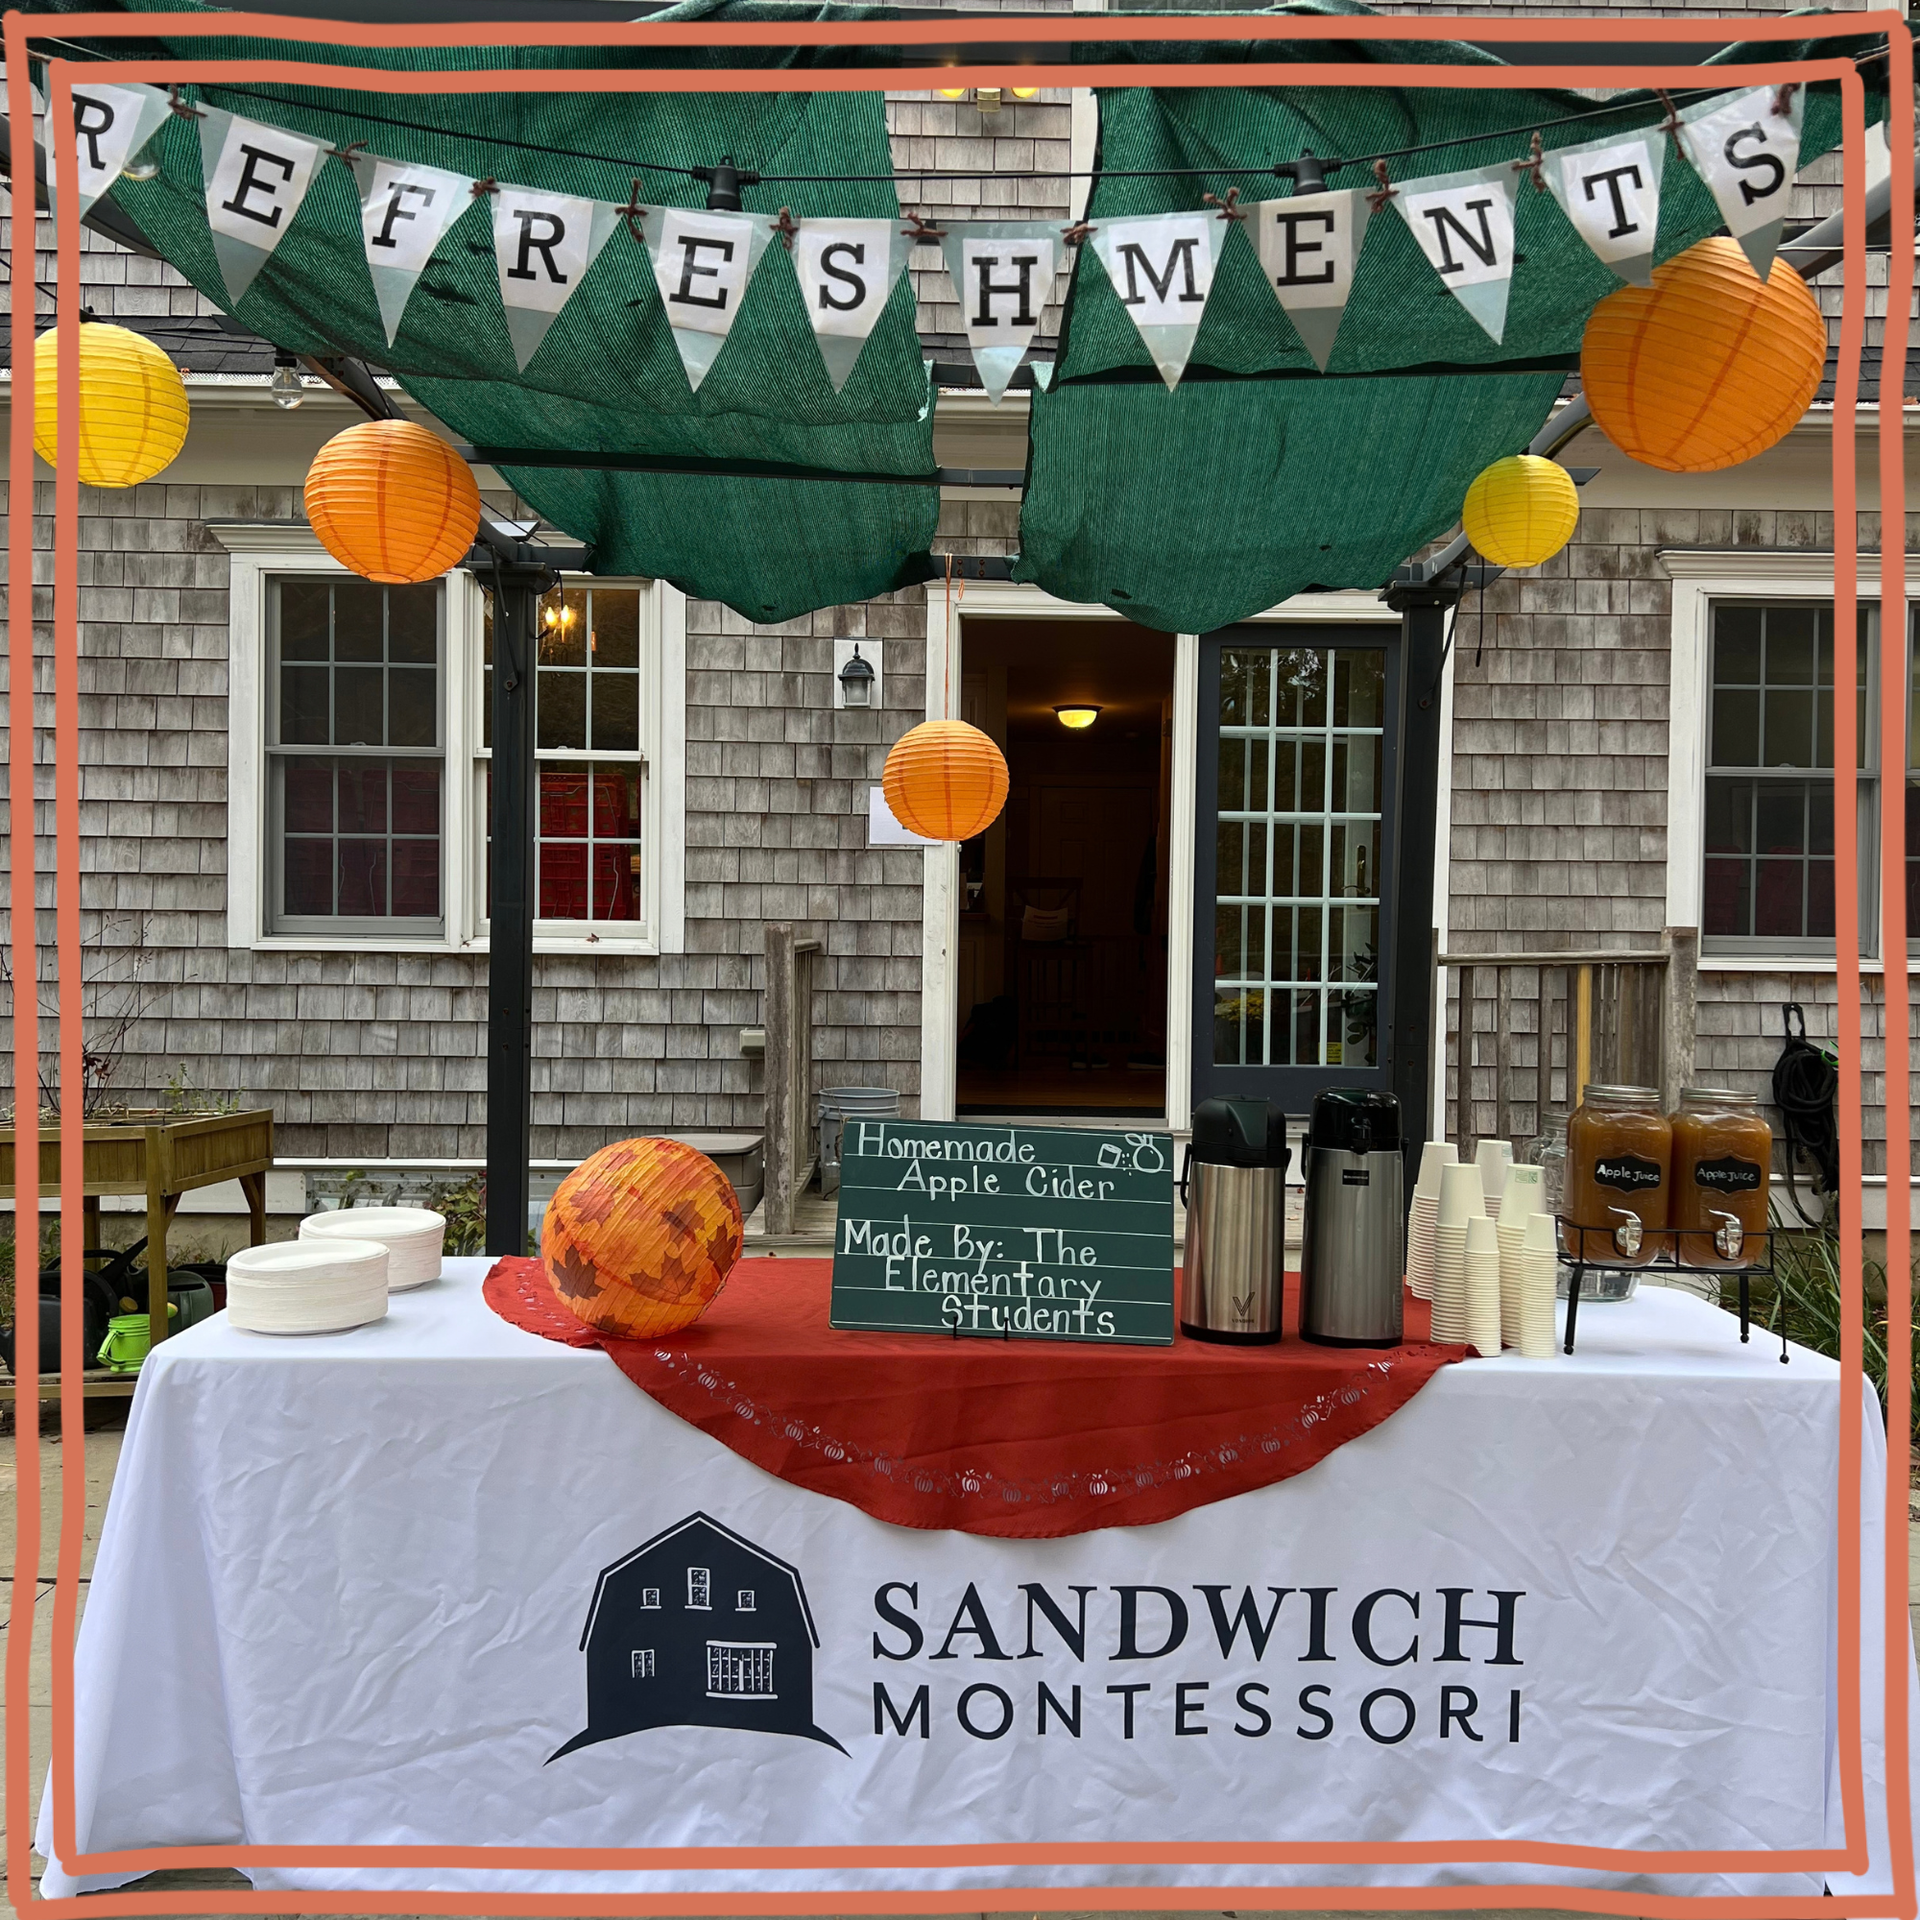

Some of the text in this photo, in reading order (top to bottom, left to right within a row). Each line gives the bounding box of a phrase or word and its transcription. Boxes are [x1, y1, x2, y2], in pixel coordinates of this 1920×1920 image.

[859, 1122, 1035, 1163] Homemade
[897, 1159, 1115, 1201] Apple Cider
[1596, 1164, 1660, 1182] Apple Juice
[1697, 1167, 1757, 1182] Apple Juice
[843, 1214, 1098, 1274] Made By: The
[885, 1255, 1101, 1308] Elementary
[941, 1293, 1116, 1336] Students
[872, 1581, 1526, 1667] SANDWICH
[873, 1681, 1521, 1745] MONTESSORI
